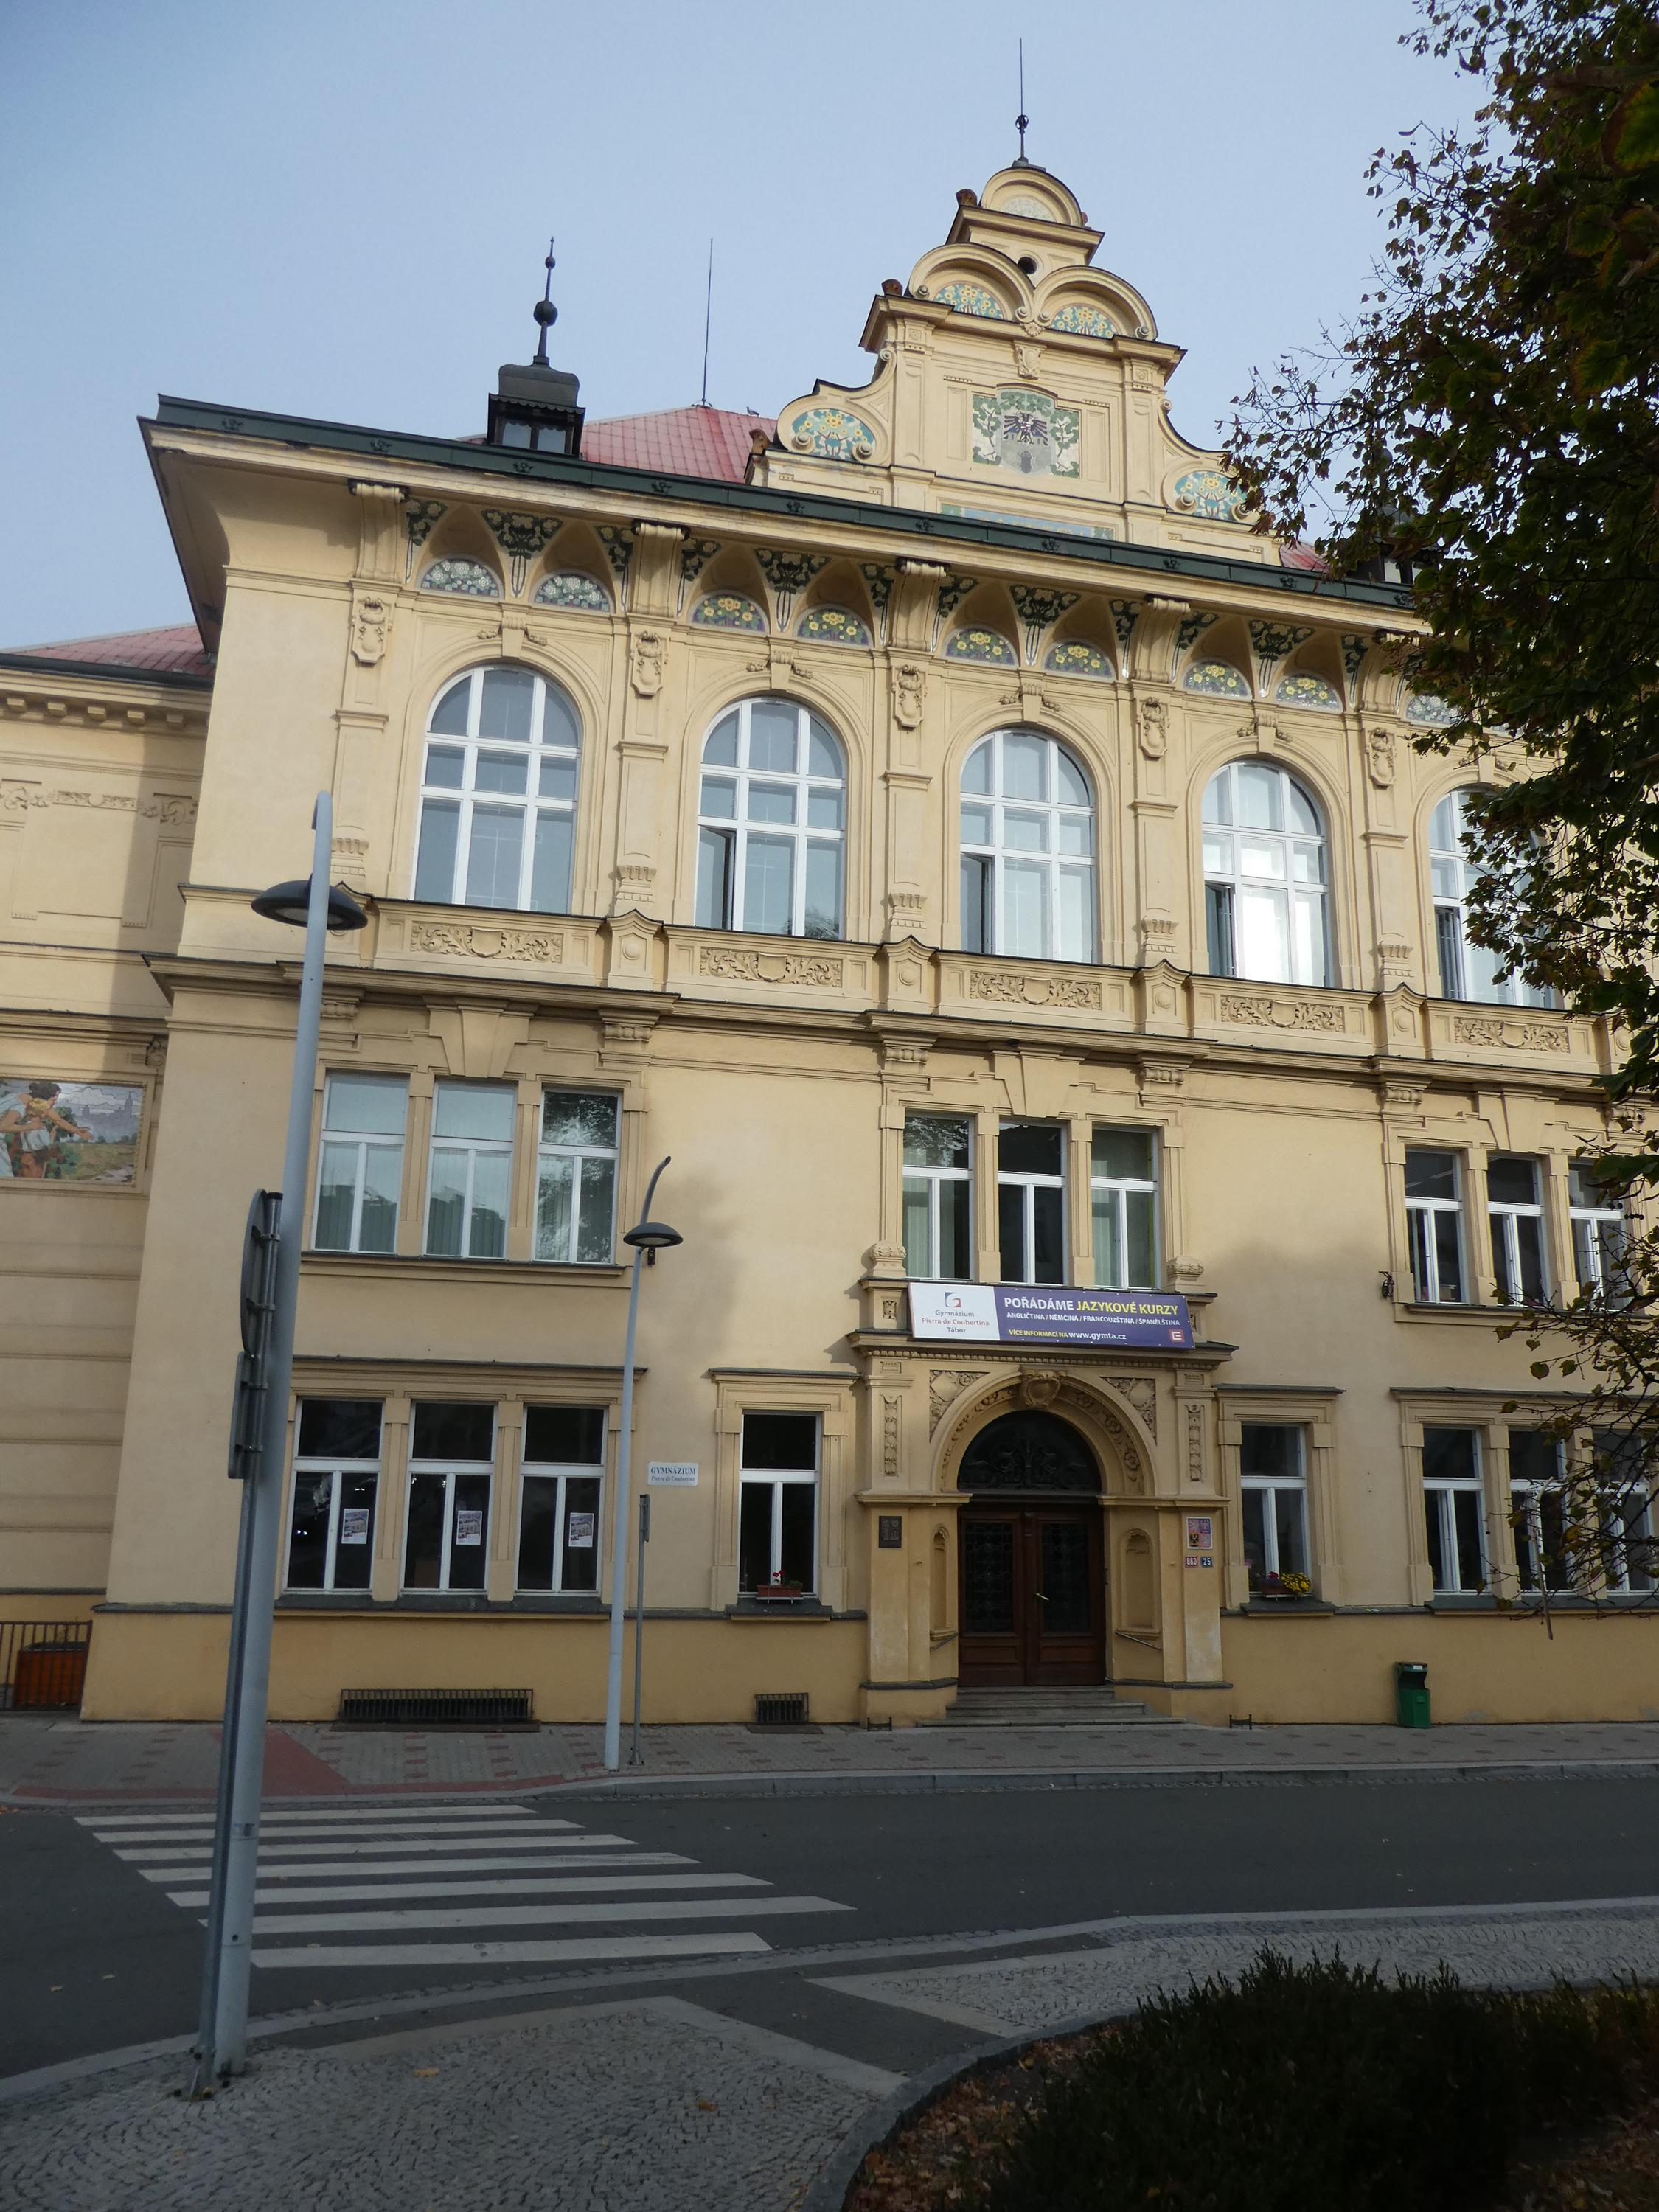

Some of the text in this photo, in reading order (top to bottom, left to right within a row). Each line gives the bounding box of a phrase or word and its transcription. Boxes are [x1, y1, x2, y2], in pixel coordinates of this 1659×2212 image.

[1004, 1296, 1178, 1315] POŘÁDÁME JAZYKOVÉ KURZY
[935, 1310, 975, 1318] Gymnázium
[1006, 1312, 1045, 1320] ANGLIČTINA
[1048, 1313, 1079, 1321] NĚMČINA
[1083, 1315, 1134, 1324] FRANCOUZŠTINA
[1138, 1317, 1180, 1326] ŠPANĚLŠTINA
[1023, 1329, 1058, 1338] INFORMACÍ
[1068, 1332, 1127, 1340] www.gymta.cz
[650, 1466, 696, 1475] GYMNÁZIUM
[1186, 1557, 1197, 1565] 860
[1203, 1557, 1211, 1565] 25
